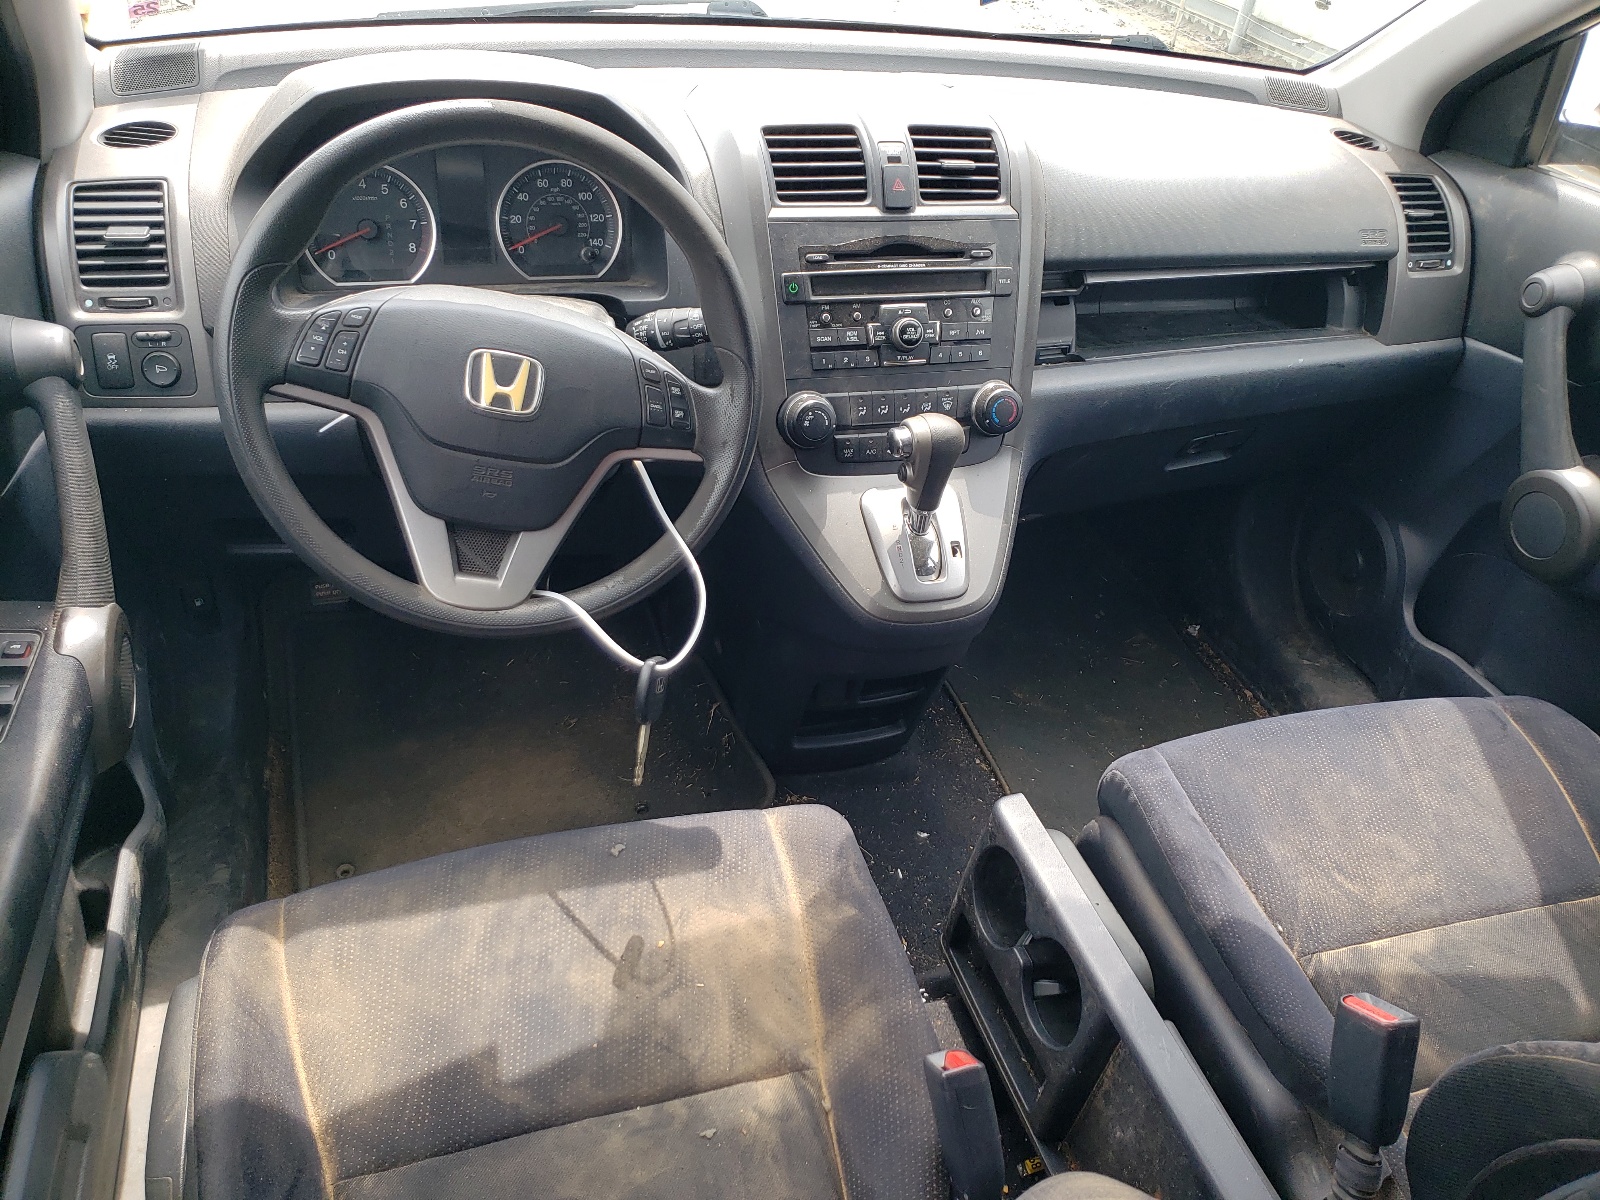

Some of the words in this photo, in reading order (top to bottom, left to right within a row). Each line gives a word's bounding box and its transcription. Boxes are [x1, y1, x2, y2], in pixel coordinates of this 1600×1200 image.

[358, 178, 366, 189] 4
[537, 179, 548, 188] 60
[561, 179, 572, 188] 80
[381, 184, 388, 194] 5
[517, 193, 528, 201] 40
[578, 192, 592, 200] 100
[400, 198, 408, 208] 6
[510, 215, 522, 223] 20
[410, 220, 417, 229] 7
[408, 242, 416, 253] 8
[328, 249, 336, 260] 0
